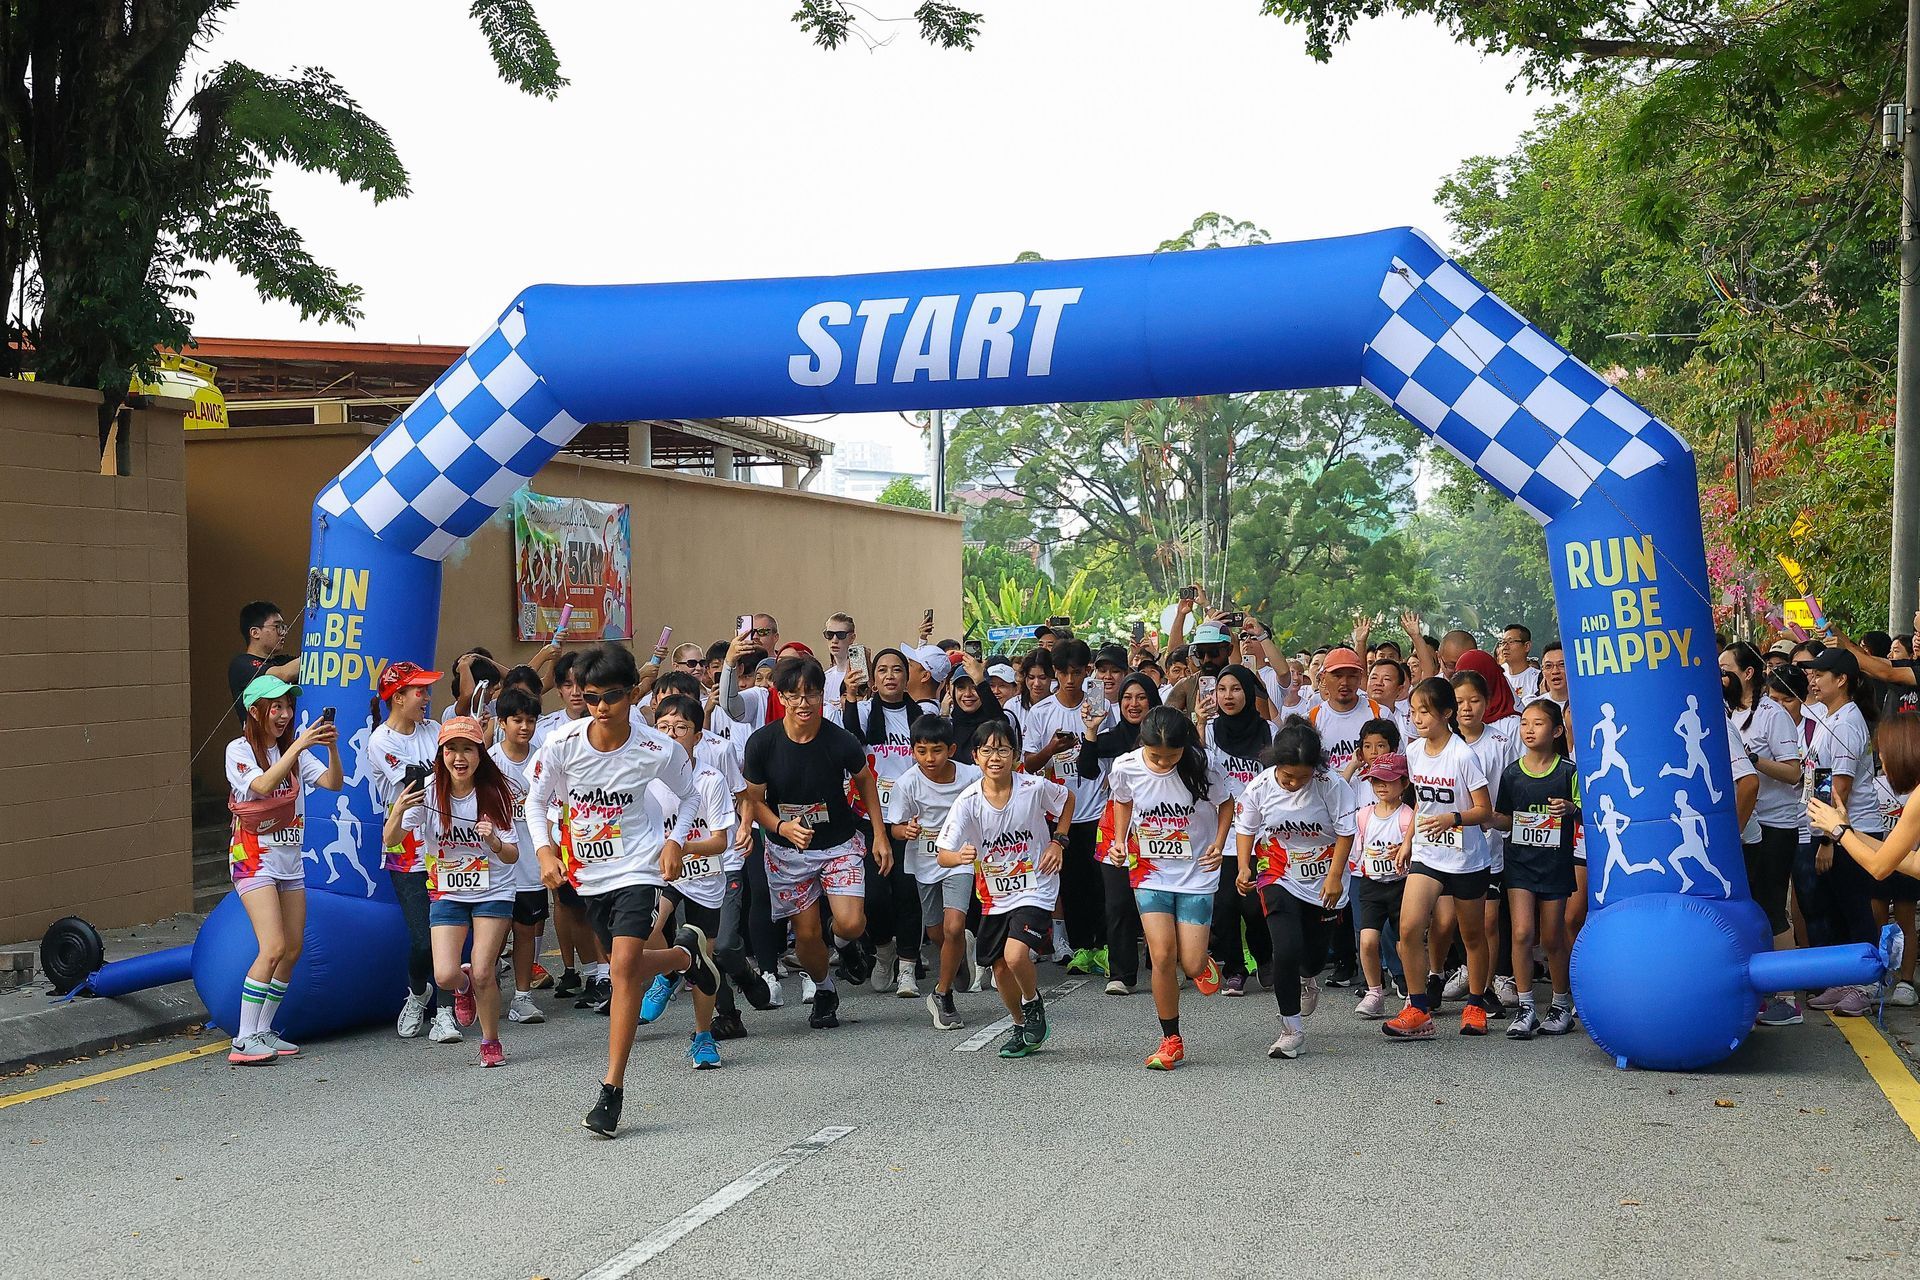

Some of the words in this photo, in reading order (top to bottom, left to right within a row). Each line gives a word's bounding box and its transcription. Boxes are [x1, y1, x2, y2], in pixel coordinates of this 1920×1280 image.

[788, 287, 1084, 387] START
[1565, 534, 1657, 590] RUN
[1581, 614, 1610, 633] AND
[1611, 587, 1662, 630] BE
[304, 632, 321, 647] AND
[324, 613, 364, 649] BE
[1574, 628, 1701, 677] HAPPY.
[298, 651, 388, 691] HAPPY
[639, 740, 663, 751] 2025
[1139, 801, 1196, 819] HIMALAYA
[273, 829, 300, 842] 0036
[982, 829, 1034, 848] HIMALAYA
[1522, 827, 1551, 844] 0167
[576, 840, 614, 858] 0200
[1148, 840, 1183, 855] 0228
[1373, 859, 1396, 873] 010
[447, 872, 481, 888] 0052
[995, 874, 1027, 892] 0237
